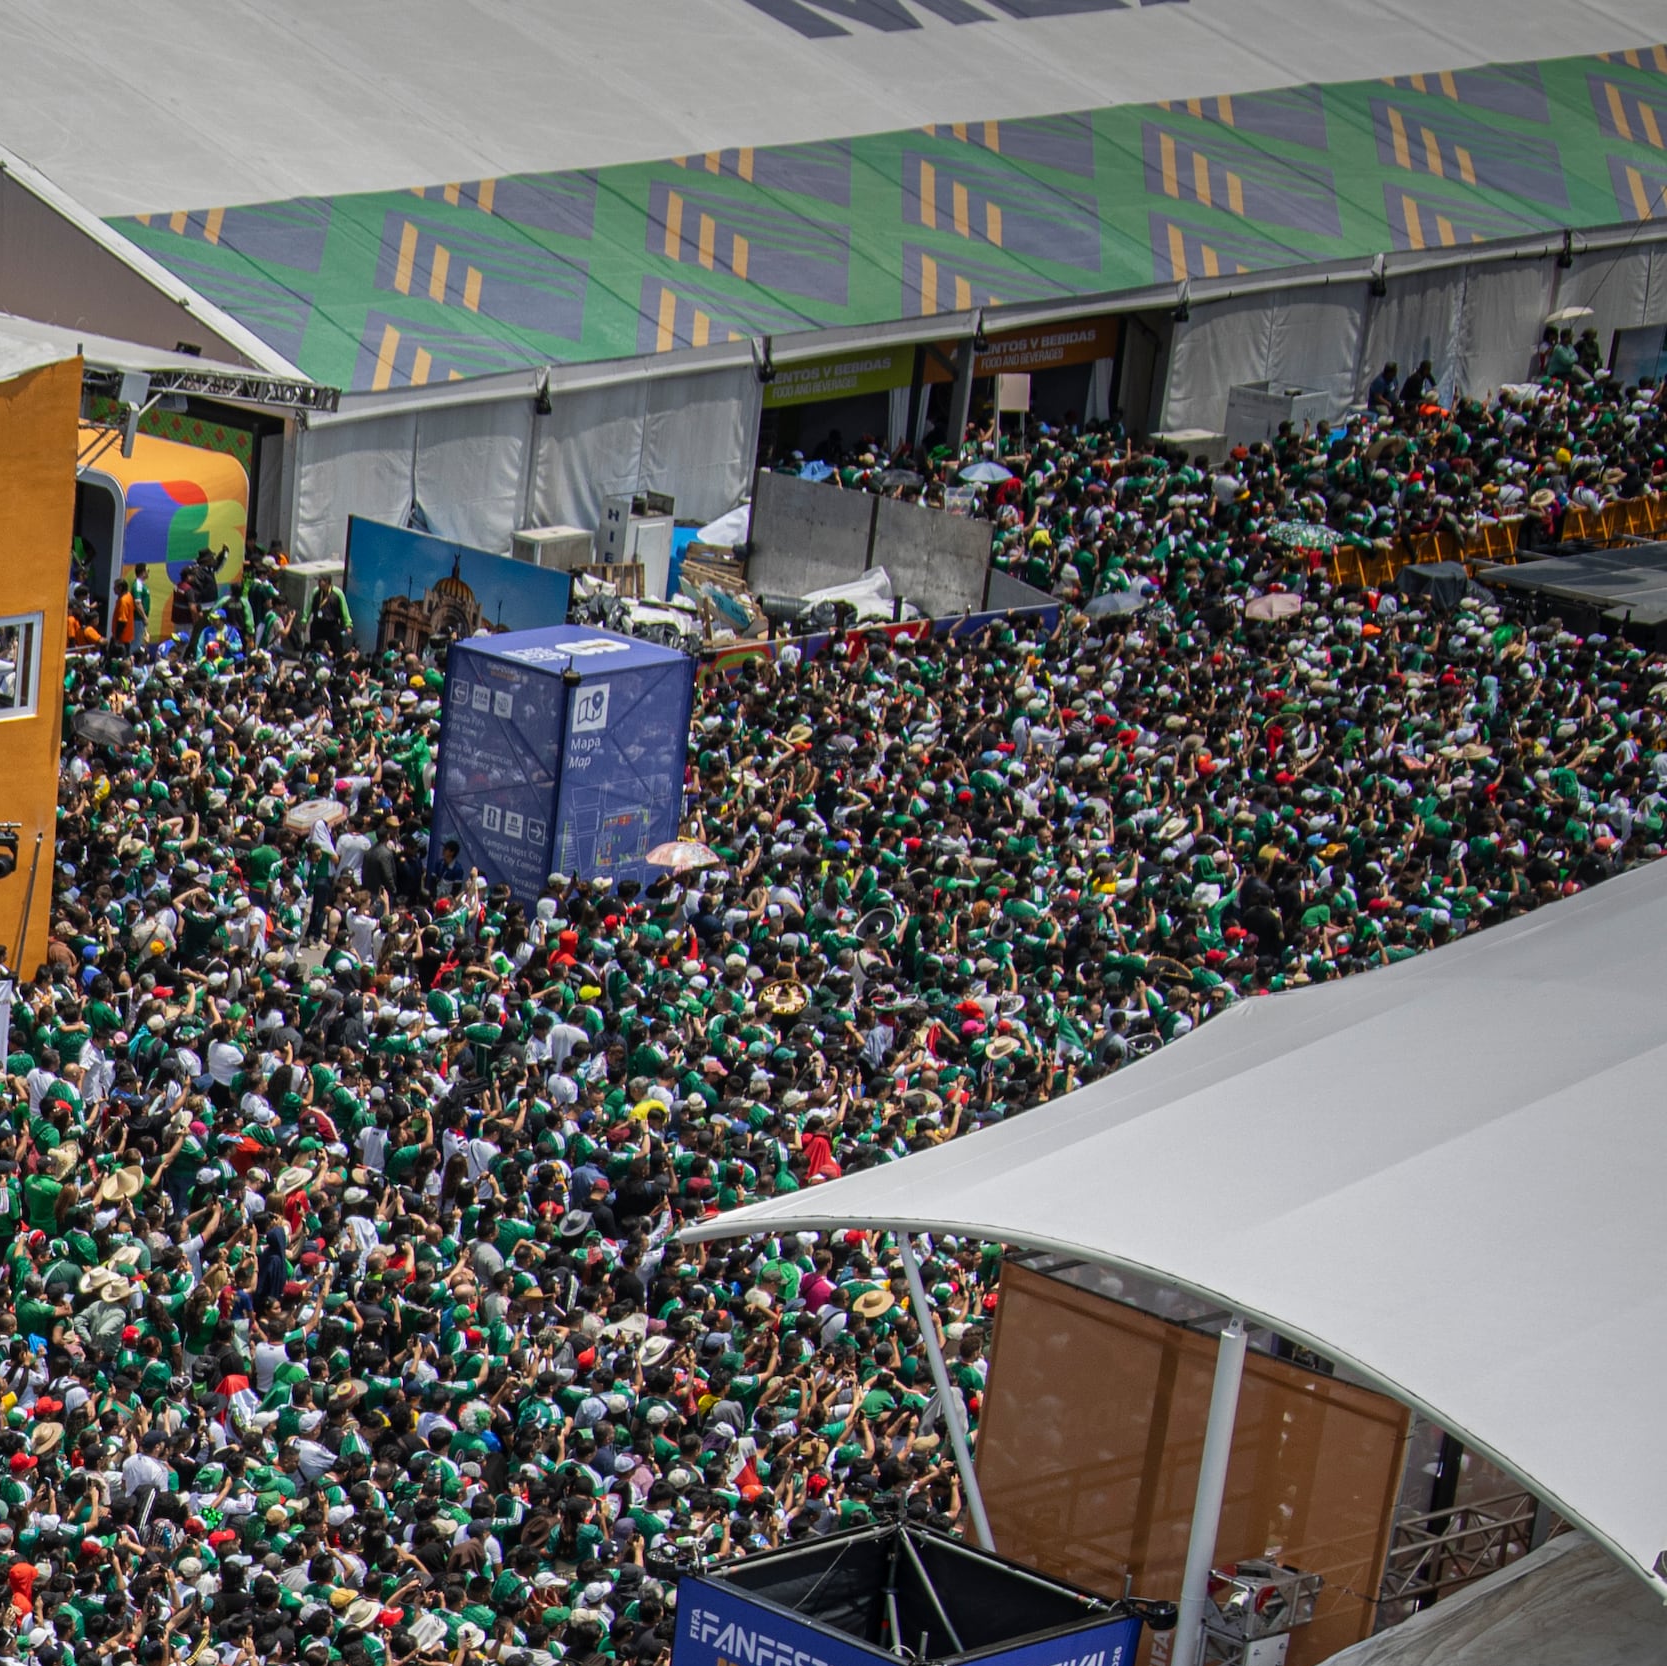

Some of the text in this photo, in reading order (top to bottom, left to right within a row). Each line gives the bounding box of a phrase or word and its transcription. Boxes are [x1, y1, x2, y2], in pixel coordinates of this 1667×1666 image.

[571, 736, 601, 751] Mapa
[569, 756, 591, 770] Map
[689, 1608, 701, 1640] FIFA
